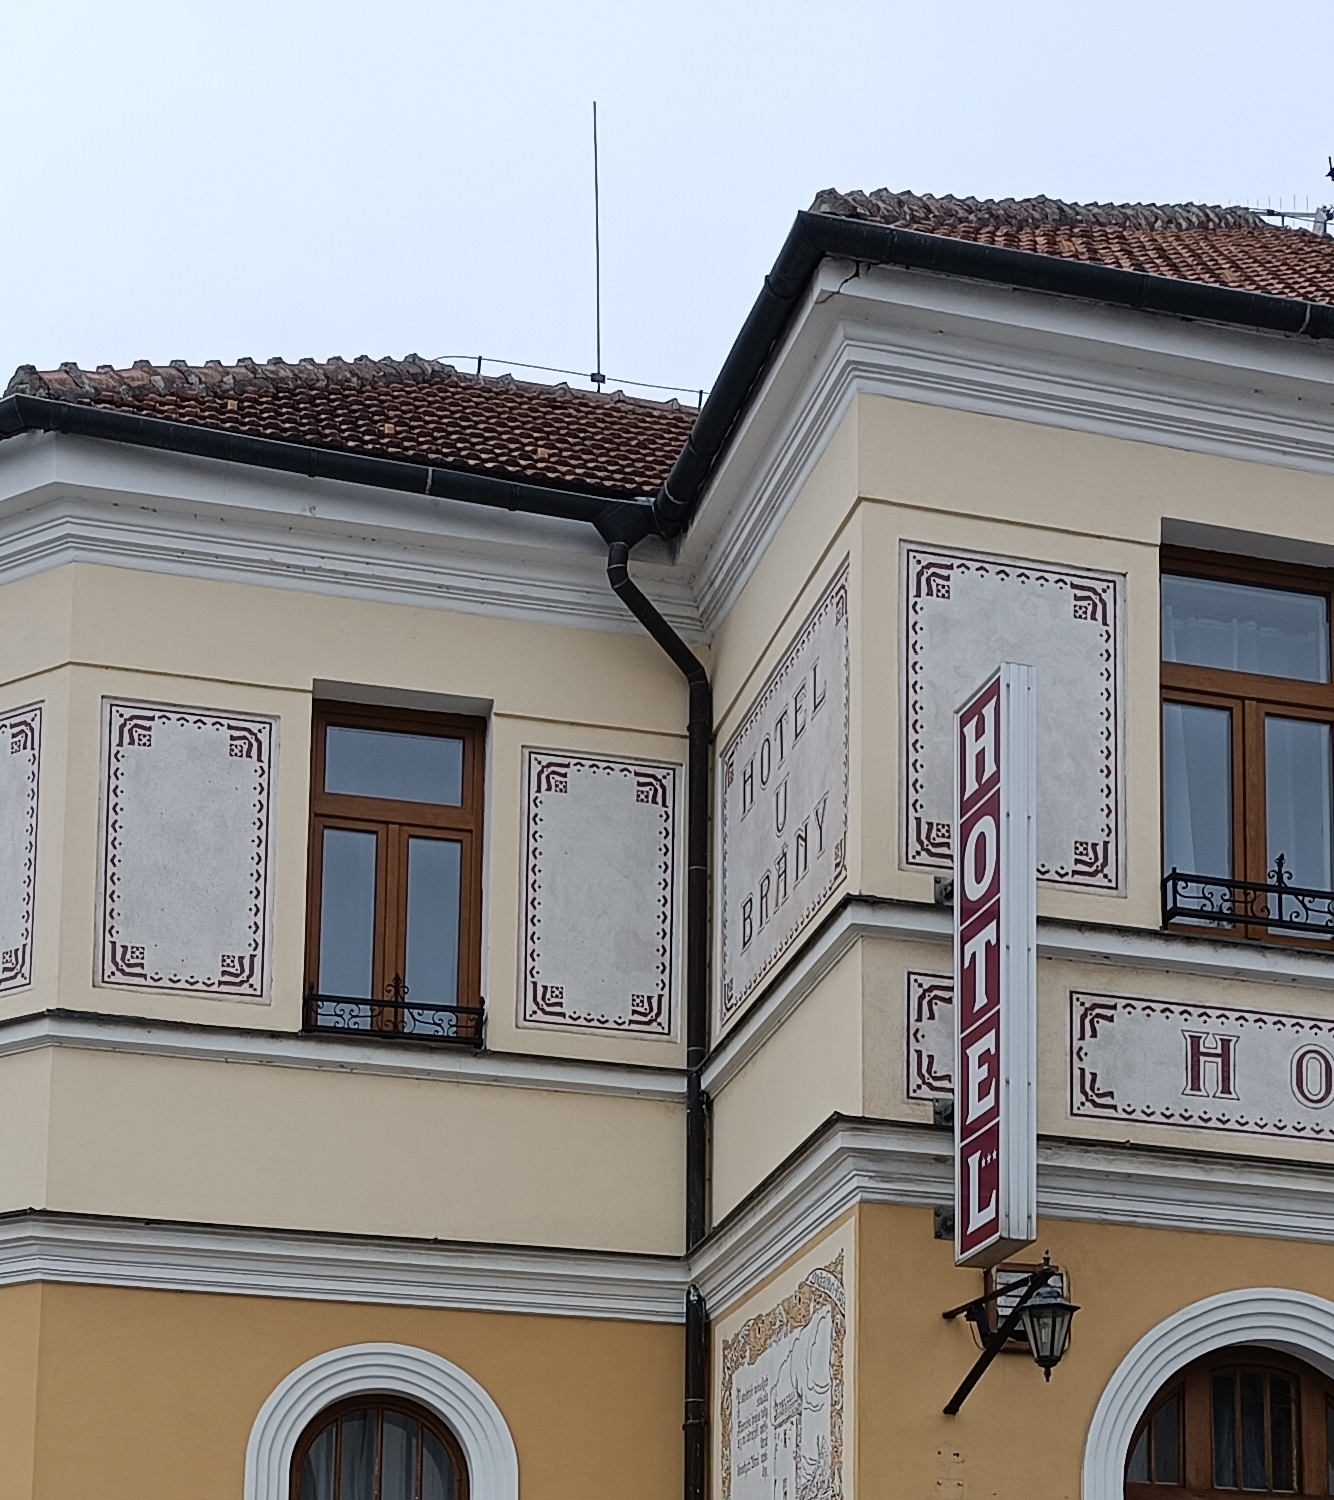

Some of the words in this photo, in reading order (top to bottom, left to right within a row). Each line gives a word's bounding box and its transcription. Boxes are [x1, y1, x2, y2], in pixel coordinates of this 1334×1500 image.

[741, 656, 827, 822] HOTEL
[773, 772, 790, 840] U
[740, 790, 829, 957] BRÁNY
[963, 694, 999, 1236] HOTEL
